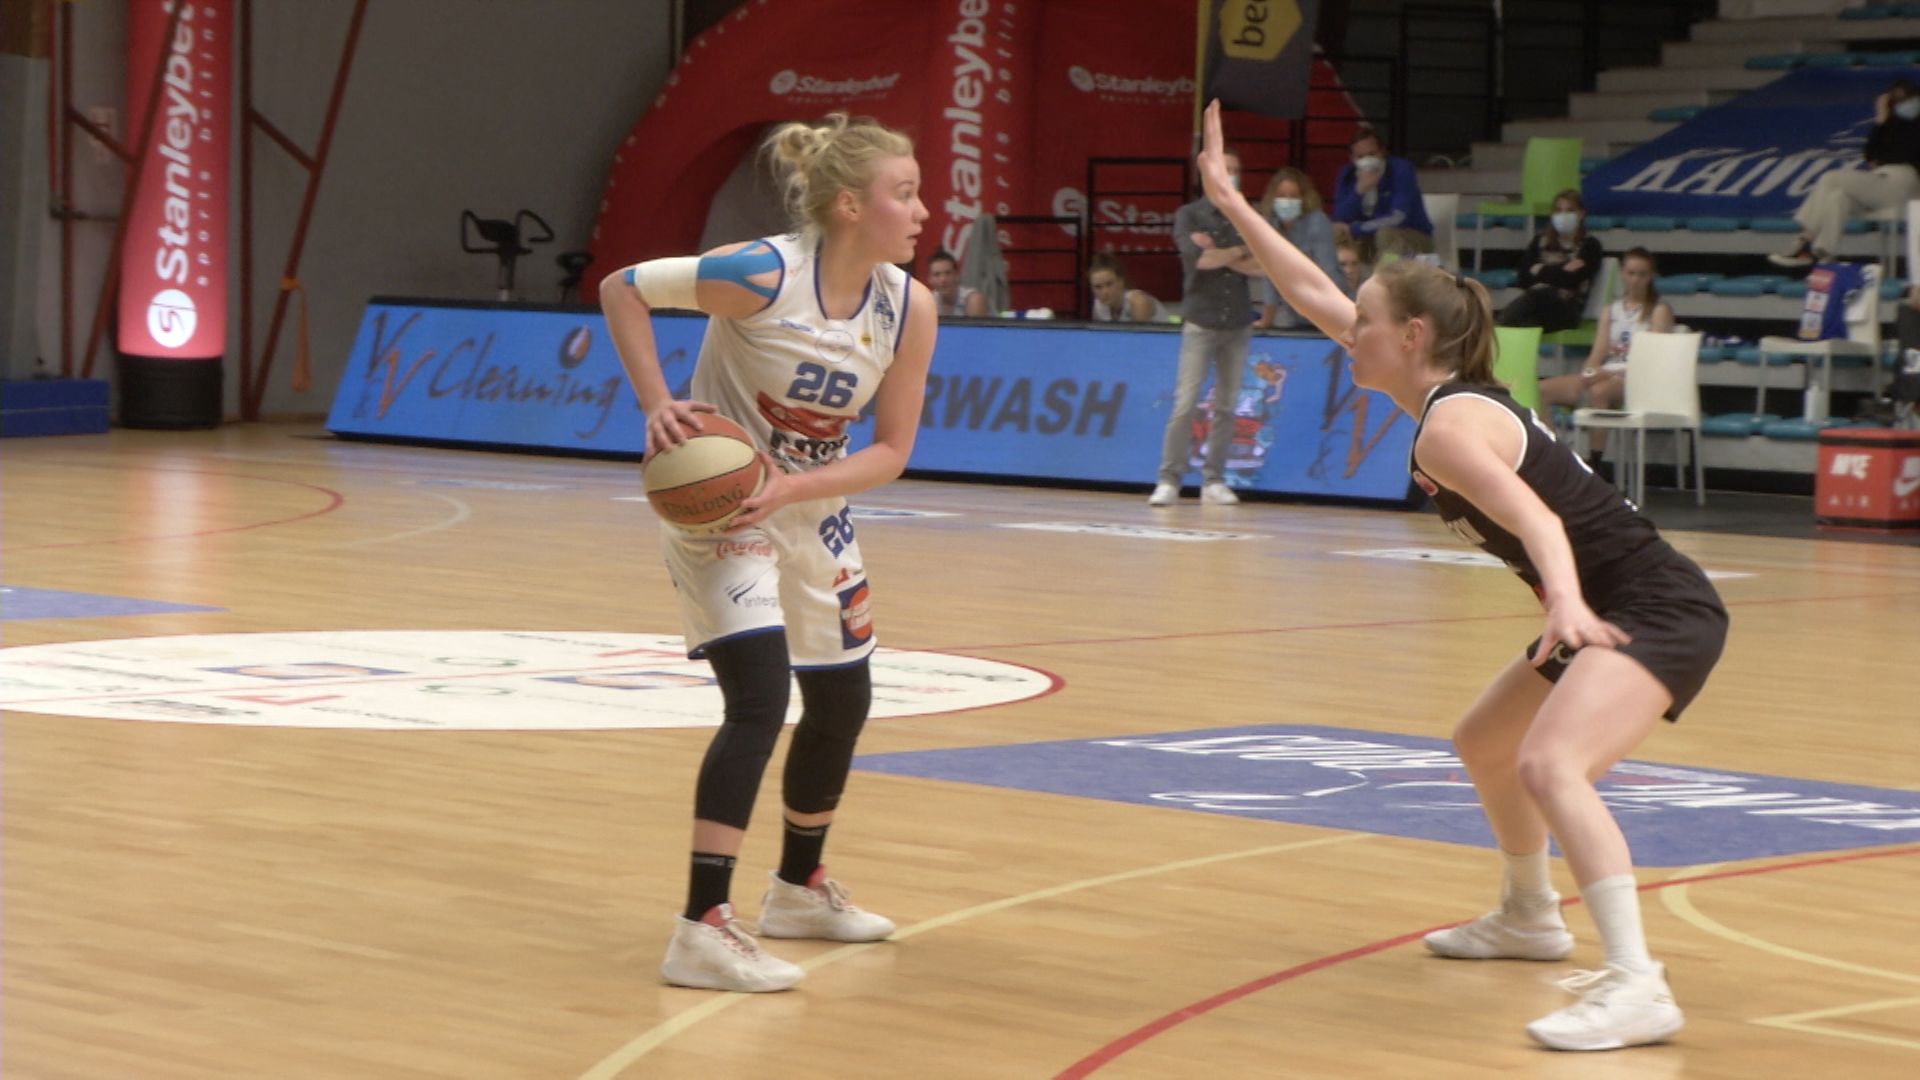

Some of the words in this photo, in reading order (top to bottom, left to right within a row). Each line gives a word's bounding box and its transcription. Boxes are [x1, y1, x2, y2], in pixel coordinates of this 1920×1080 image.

[1231, 0, 1268, 47] be
[786, 361, 858, 409] 26
[818, 505, 855, 560] 26
